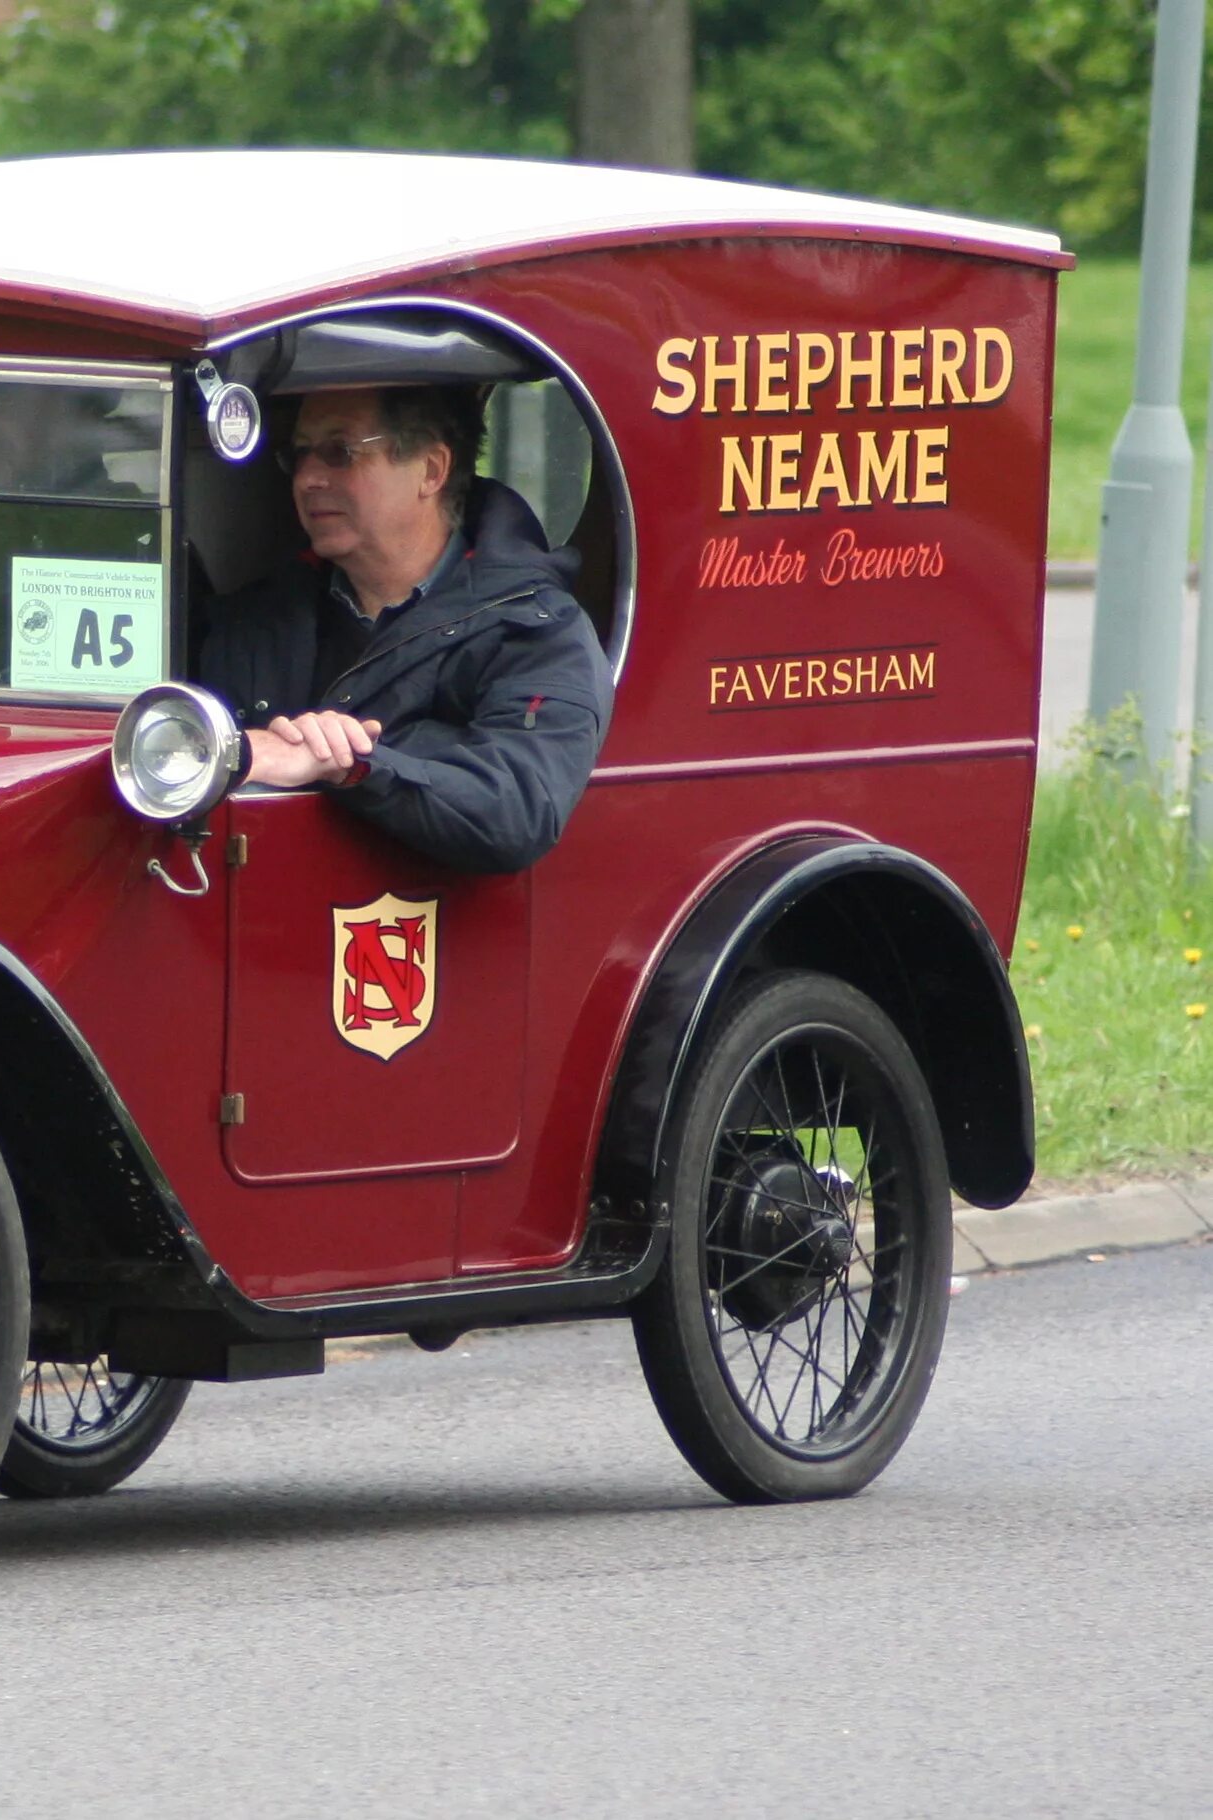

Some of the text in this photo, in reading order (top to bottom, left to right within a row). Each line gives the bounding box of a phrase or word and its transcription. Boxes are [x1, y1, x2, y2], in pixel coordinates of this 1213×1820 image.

[652, 326, 1014, 415] SHEPHERD
[719, 426, 950, 513] NEAME
[698, 527, 944, 589] Master Brewers
[21, 583, 156, 600] LONDON TO BRIGHTON RUN
[71, 608, 134, 669] A5
[709, 652, 936, 704] FAVERSHAM
